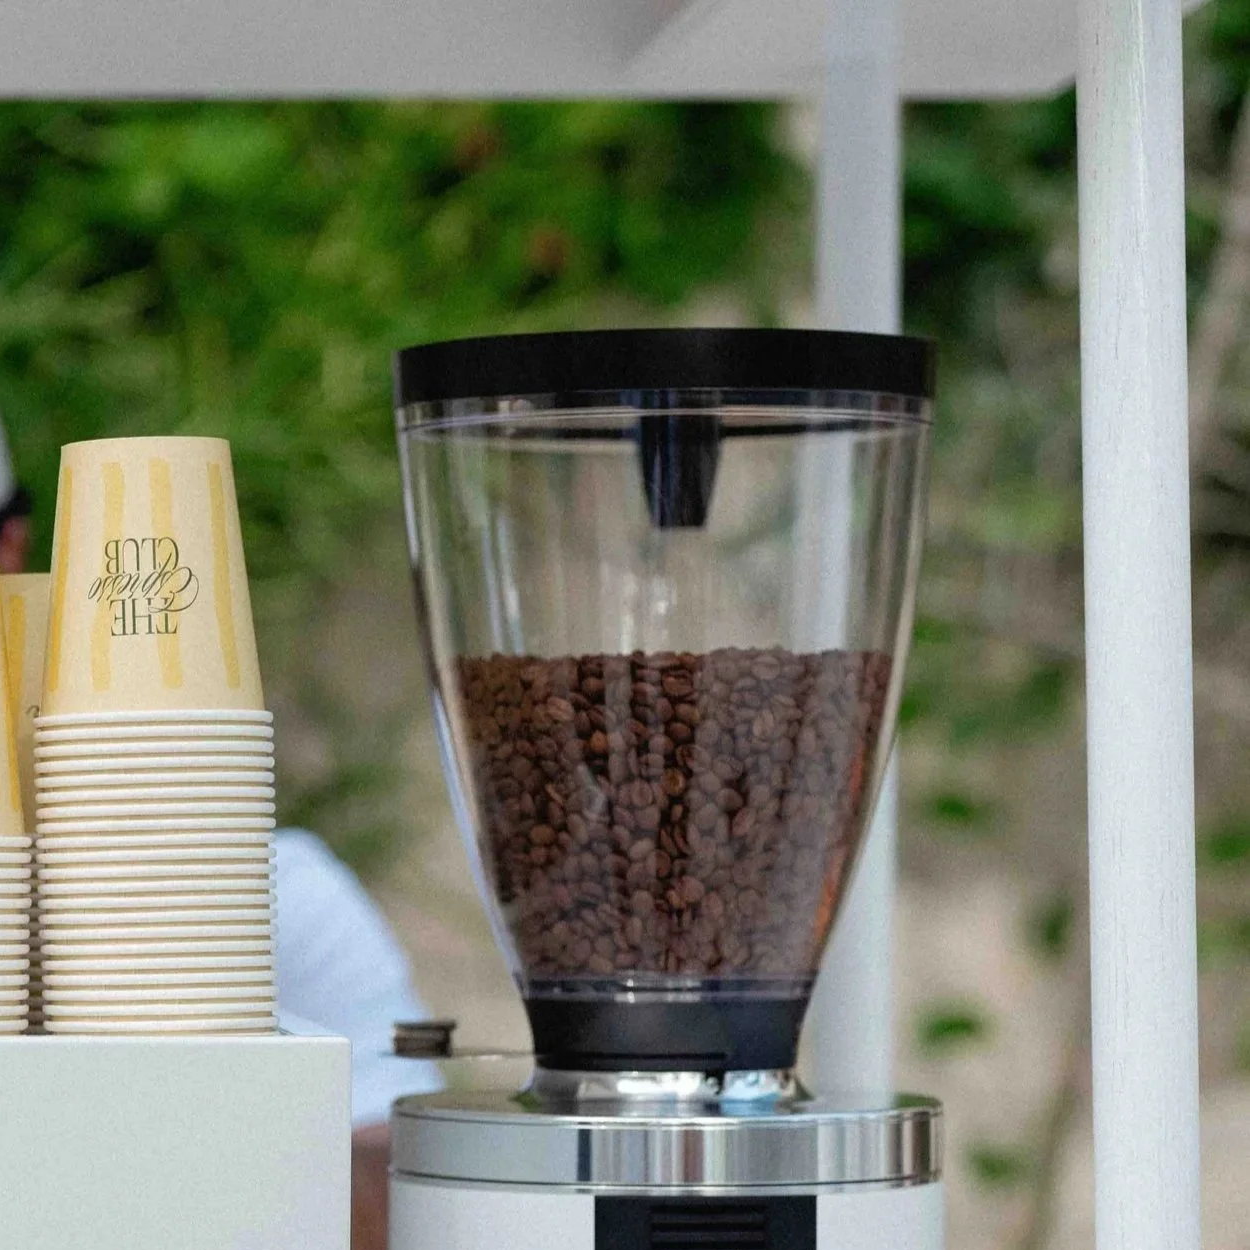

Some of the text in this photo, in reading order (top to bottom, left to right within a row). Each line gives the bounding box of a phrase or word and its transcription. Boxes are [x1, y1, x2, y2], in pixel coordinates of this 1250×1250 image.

[104, 536, 180, 575] CLUB
[87, 553, 199, 613] Espresso
[110, 597, 178, 637] THE
